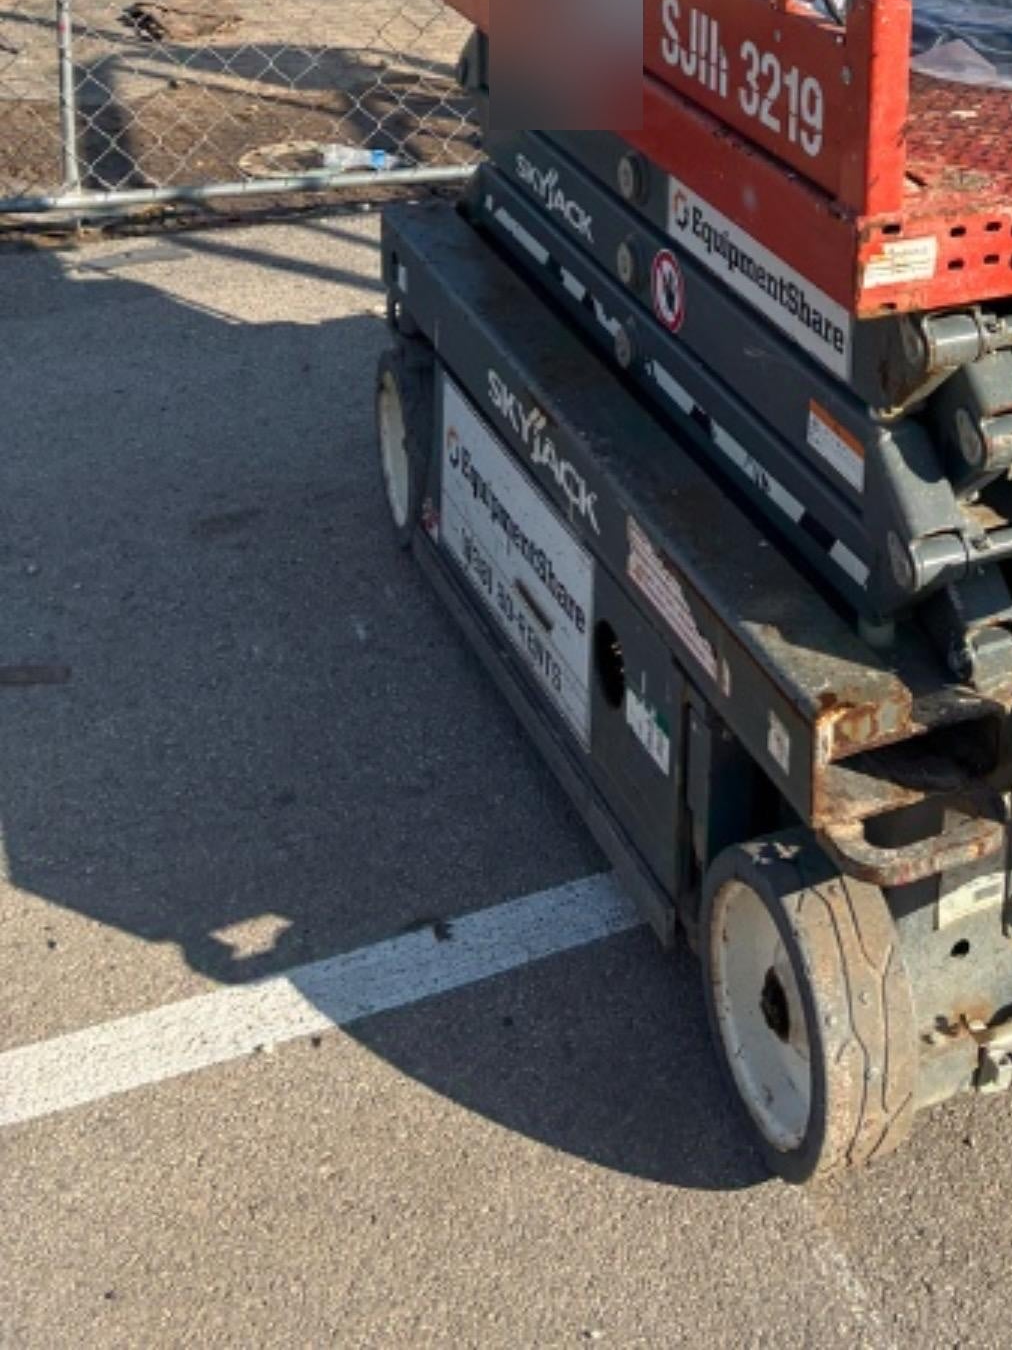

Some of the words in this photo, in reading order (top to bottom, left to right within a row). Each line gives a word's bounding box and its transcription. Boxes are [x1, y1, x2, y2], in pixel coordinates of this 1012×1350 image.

[738, 40, 823, 157] 3219
[515, 153, 594, 244] SKYJACK
[692, 206, 844, 354] EquipmentShare
[488, 368, 600, 535] SKYJACK
